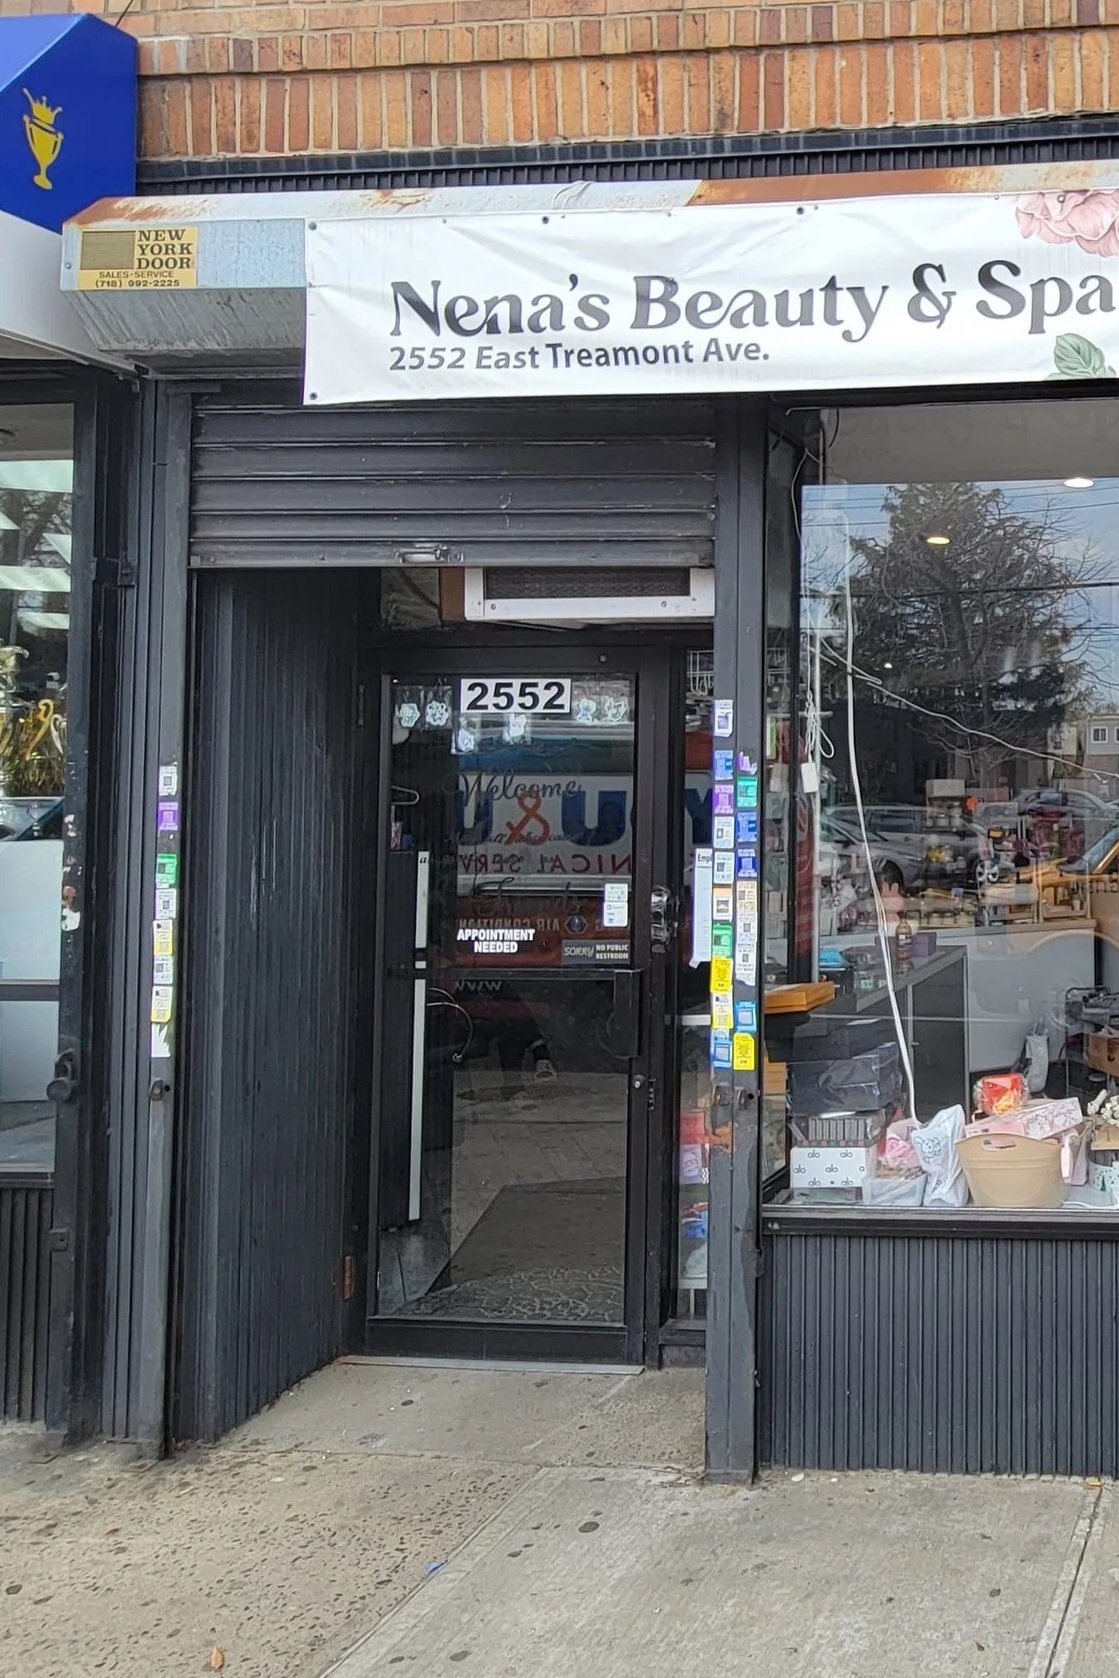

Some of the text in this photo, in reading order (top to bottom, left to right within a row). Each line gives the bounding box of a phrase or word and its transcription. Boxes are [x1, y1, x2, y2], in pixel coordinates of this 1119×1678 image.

[137, 229, 186, 242] NEW
[137, 243, 193, 256] YORK
[136, 257, 192, 270] DOOR
[98, 270, 175, 279] SALES-SERVICE
[95, 279, 180, 289] (718) 992-2225
[389, 259, 1117, 344] Nena's Beauty & Spa
[389, 337, 771, 372] 2552 East Treamont Ave.
[466, 681, 566, 710] 2552
[459, 769, 582, 808] Welcome
[456, 928, 536, 941] APPOINTMENT
[473, 941, 519, 954] NEEDED
